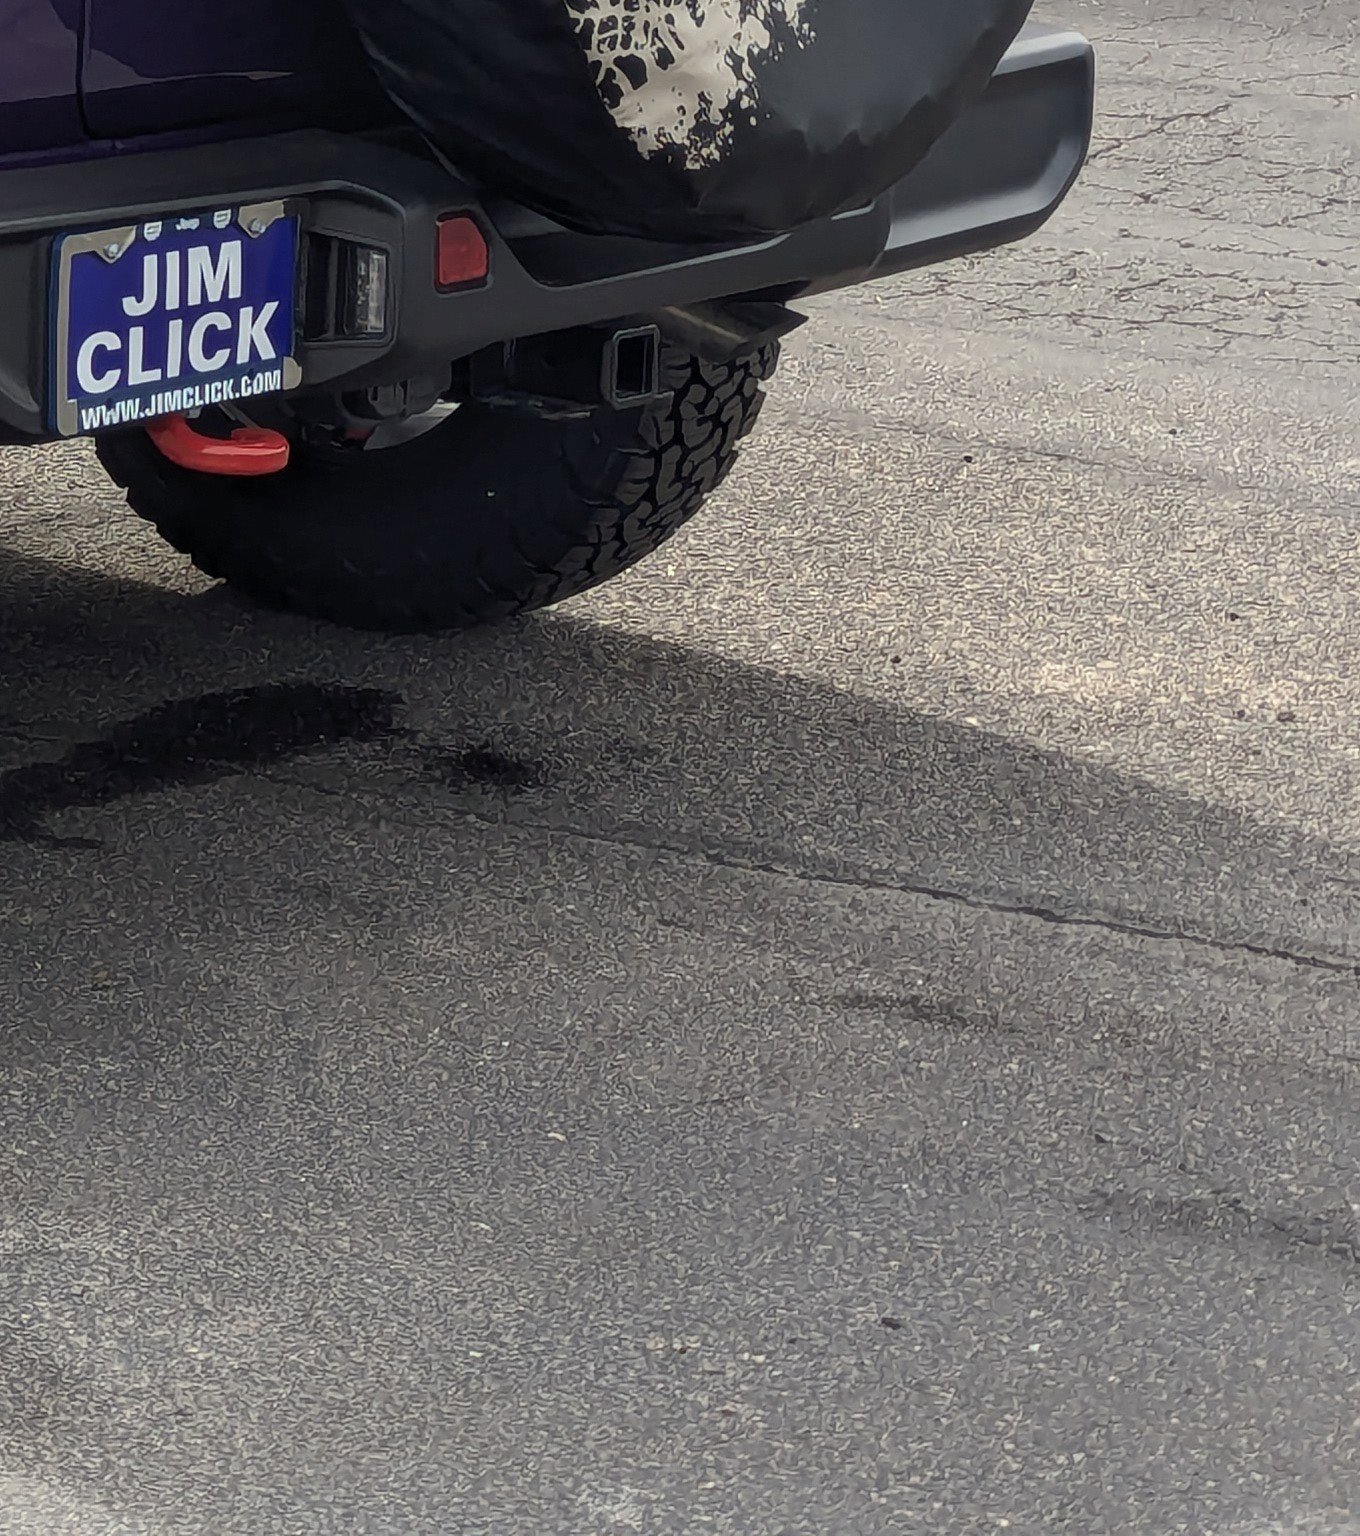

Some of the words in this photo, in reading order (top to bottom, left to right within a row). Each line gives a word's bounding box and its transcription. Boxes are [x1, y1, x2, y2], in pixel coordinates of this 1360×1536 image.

[122, 240, 242, 316] JIM
[76, 301, 279, 394] CLICK
[81, 369, 281, 430] WWW.JIMCLICK.COM
